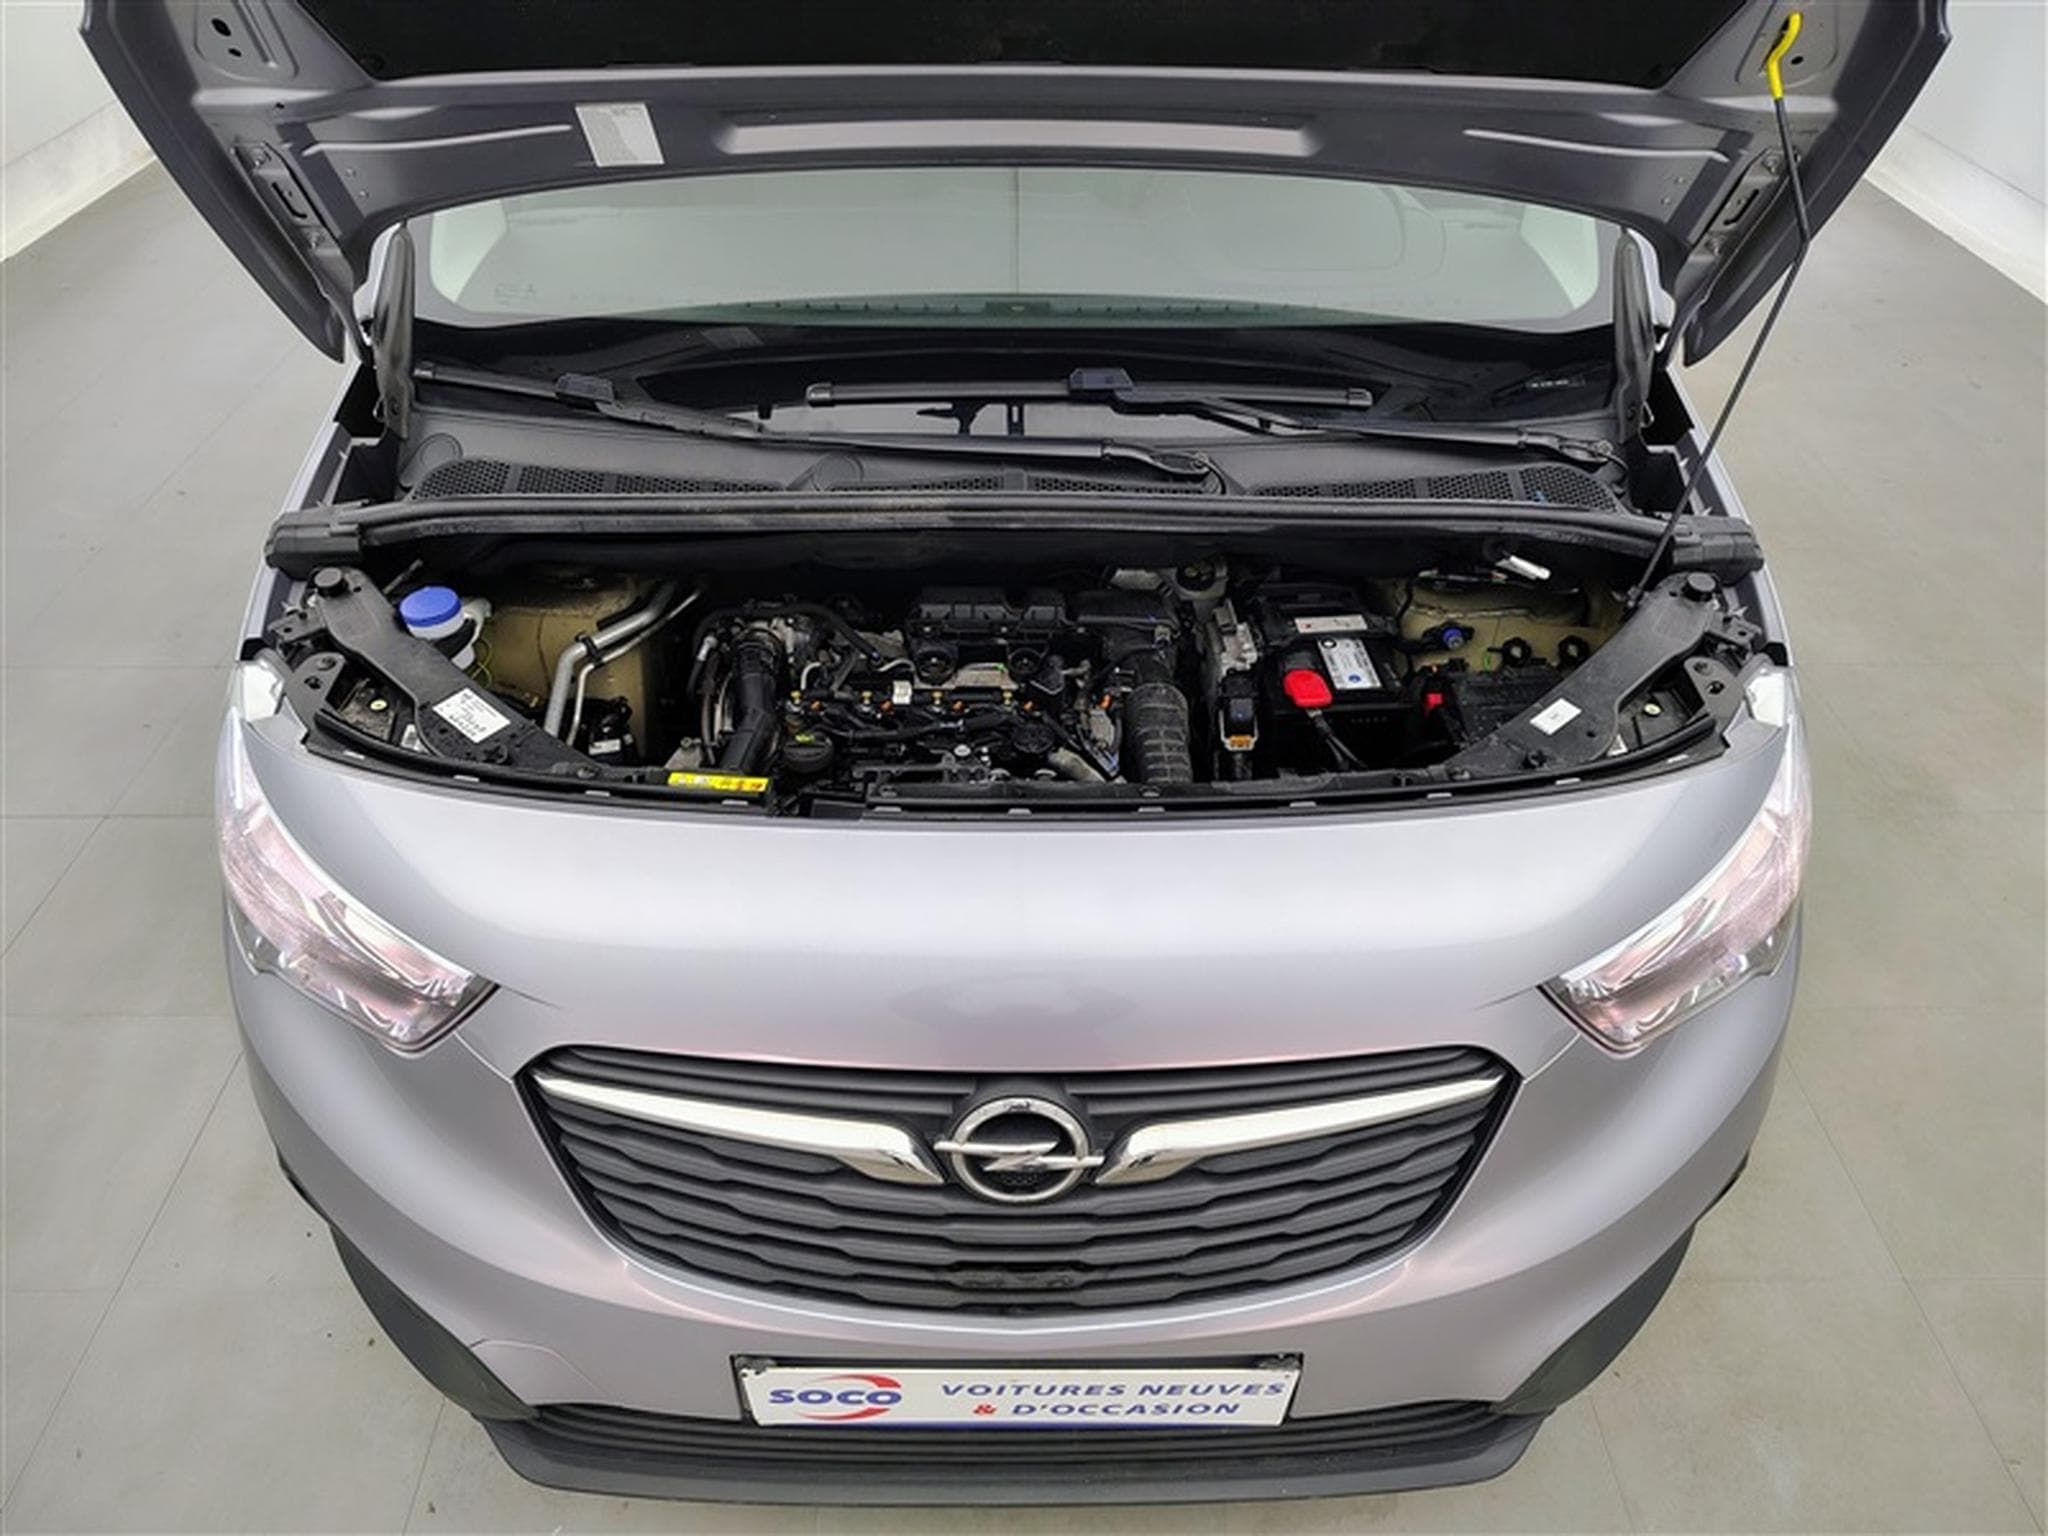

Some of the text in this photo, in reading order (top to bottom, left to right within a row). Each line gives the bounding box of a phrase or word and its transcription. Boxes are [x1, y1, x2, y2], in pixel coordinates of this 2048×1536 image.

[942, 1383, 1286, 1396] VOITURES NEUVES
[769, 1389, 902, 1405] SOCO
[973, 1403, 1240, 1416] & D'OCCASION
